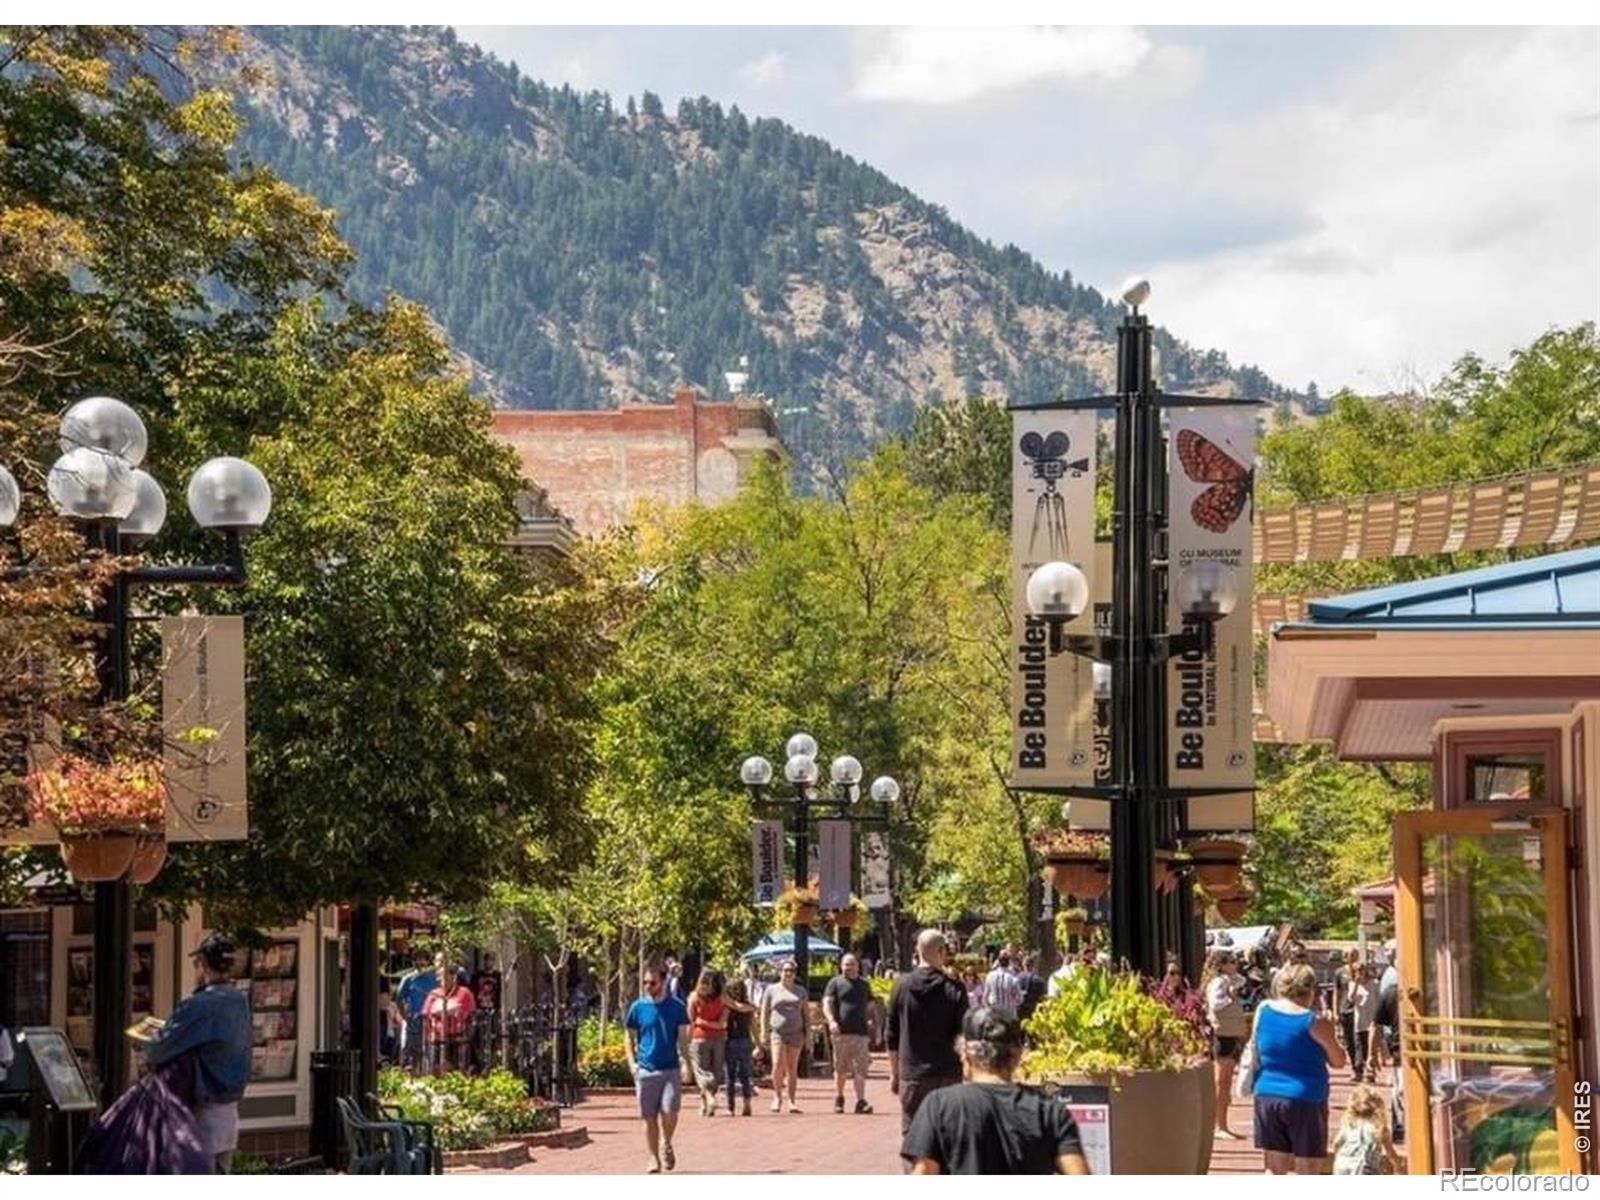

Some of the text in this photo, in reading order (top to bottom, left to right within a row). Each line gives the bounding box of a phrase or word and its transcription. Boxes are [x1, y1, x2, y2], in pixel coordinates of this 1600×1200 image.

[1197, 548, 1242, 558] MUSEUM
[1019, 615, 1046, 769] Be Boulder
[1206, 665, 1217, 713] NATURAL
[1175, 733, 1204, 770] Be
